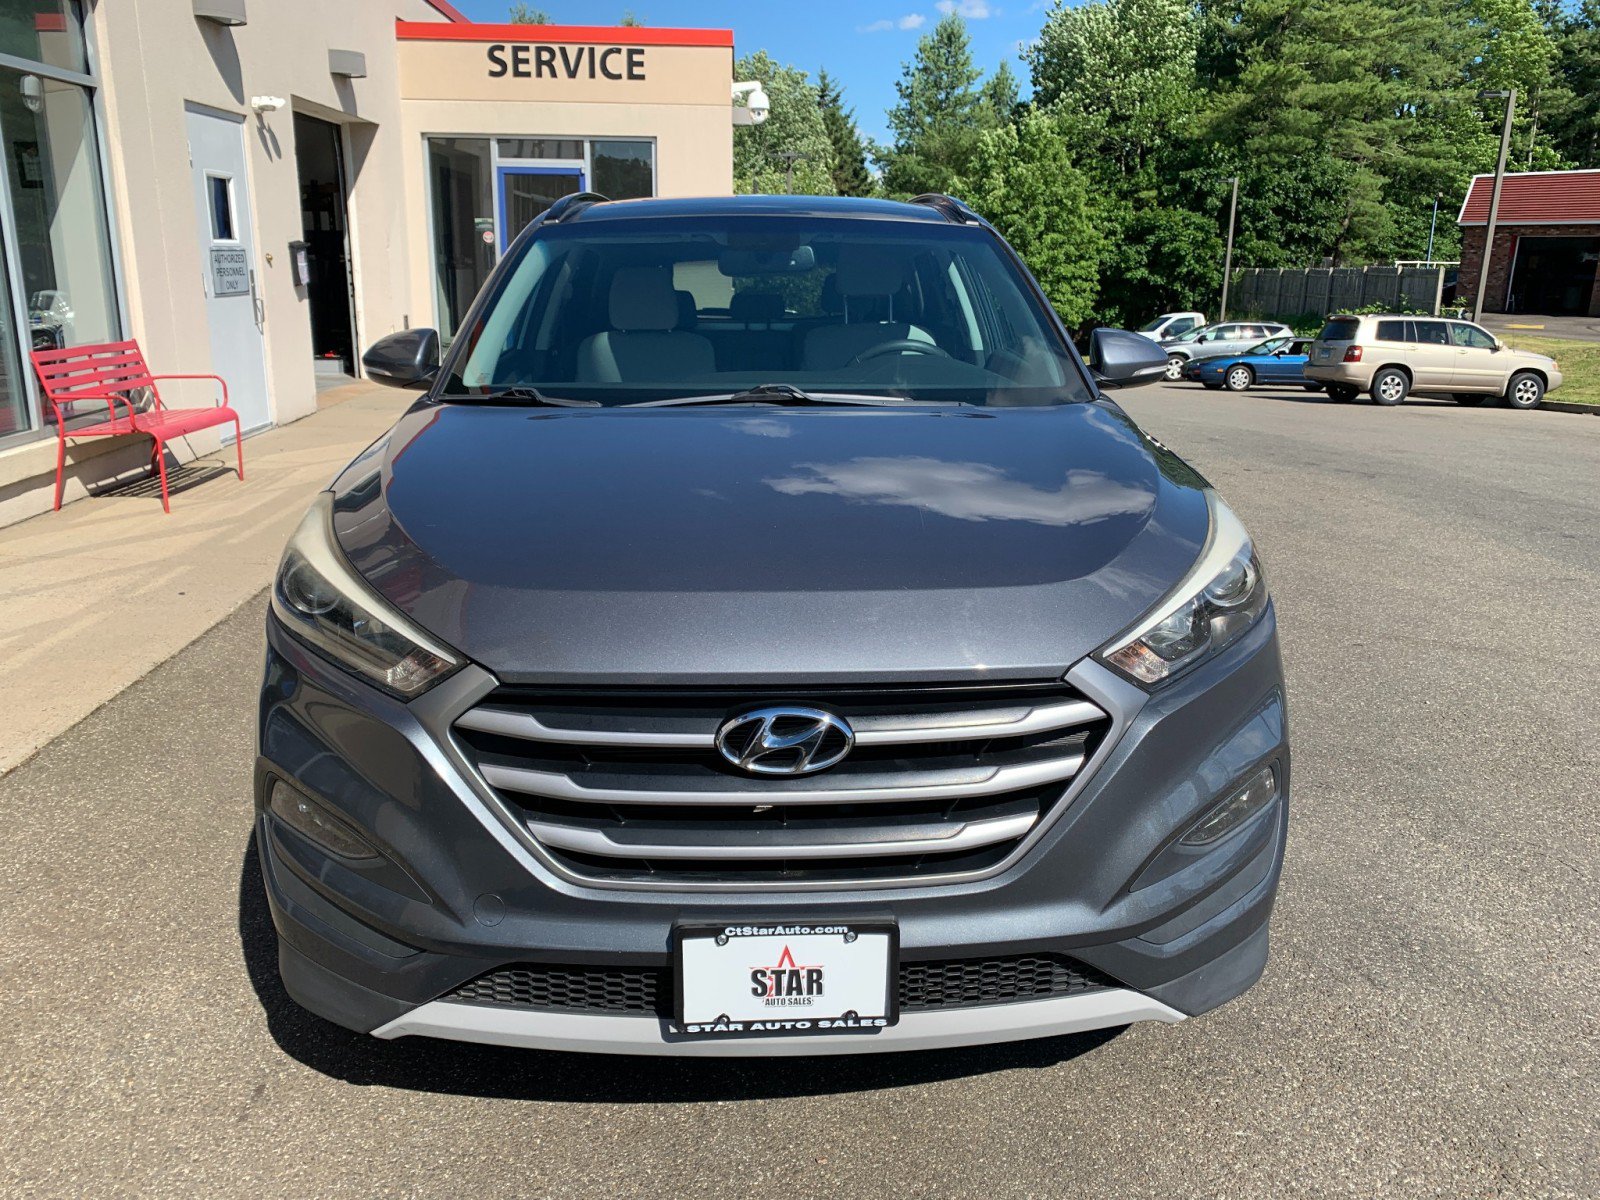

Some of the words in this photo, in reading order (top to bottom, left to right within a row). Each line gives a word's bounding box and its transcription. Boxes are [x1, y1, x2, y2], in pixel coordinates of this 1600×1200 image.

[487, 44, 646, 80] SERVICE
[214, 254, 244, 264] AUTHORIZED
[216, 267, 245, 276] PERSONNEL
[225, 280, 239, 289] ONLY
[724, 925, 848, 936] CtStarAuto.com
[751, 968, 823, 997] STAR
[765, 997, 786, 1006] AUTO
[788, 997, 812, 1006] SALES
[686, 1023, 744, 1033] STAR
[750, 1021, 811, 1031] AUTO
[818, 1018, 888, 1028] SALES
